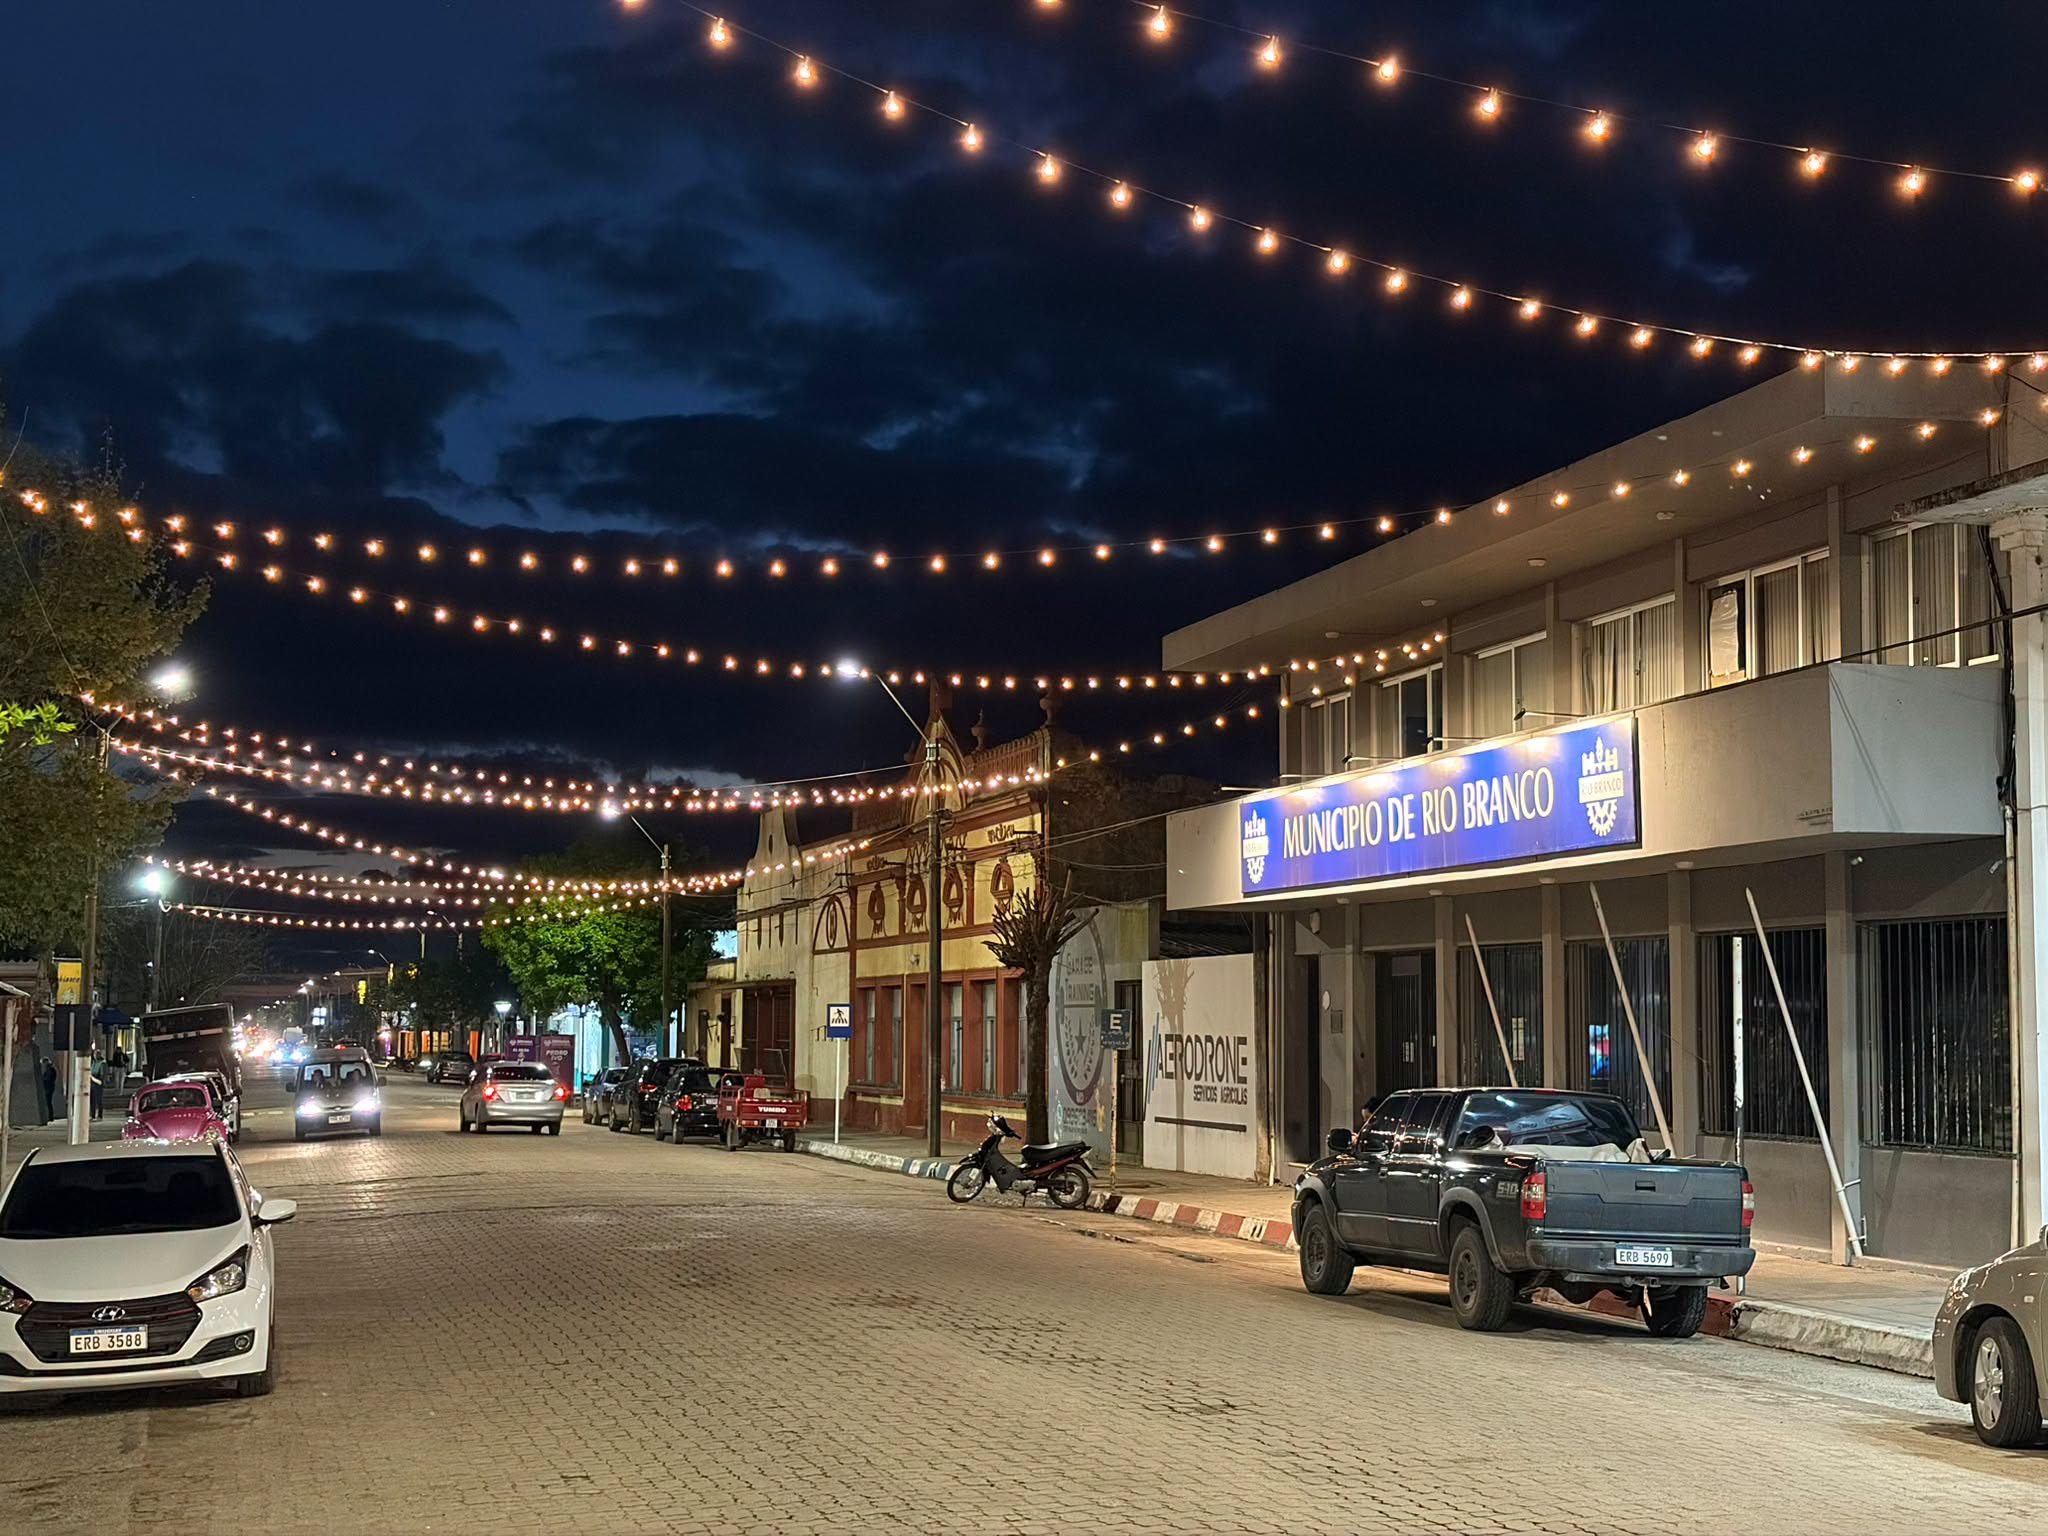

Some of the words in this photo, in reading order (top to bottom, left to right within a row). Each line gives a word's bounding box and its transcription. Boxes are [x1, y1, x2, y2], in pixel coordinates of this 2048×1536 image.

[1283, 800, 1383, 859] MUNICIPIO
[1387, 793, 1416, 843] DE
[1421, 785, 1458, 836] RIO
[1462, 766, 1554, 830] BRANCO
[1110, 1013, 1123, 1030] E
[1155, 1033, 1248, 1085] AERODRONE
[758, 1106, 787, 1114] YUMBO
[1619, 1250, 1639, 1263] ERB
[1643, 1252, 1669, 1264] 5699
[74, 1335, 101, 1351] ERB
[107, 1333, 142, 1349] 3588
